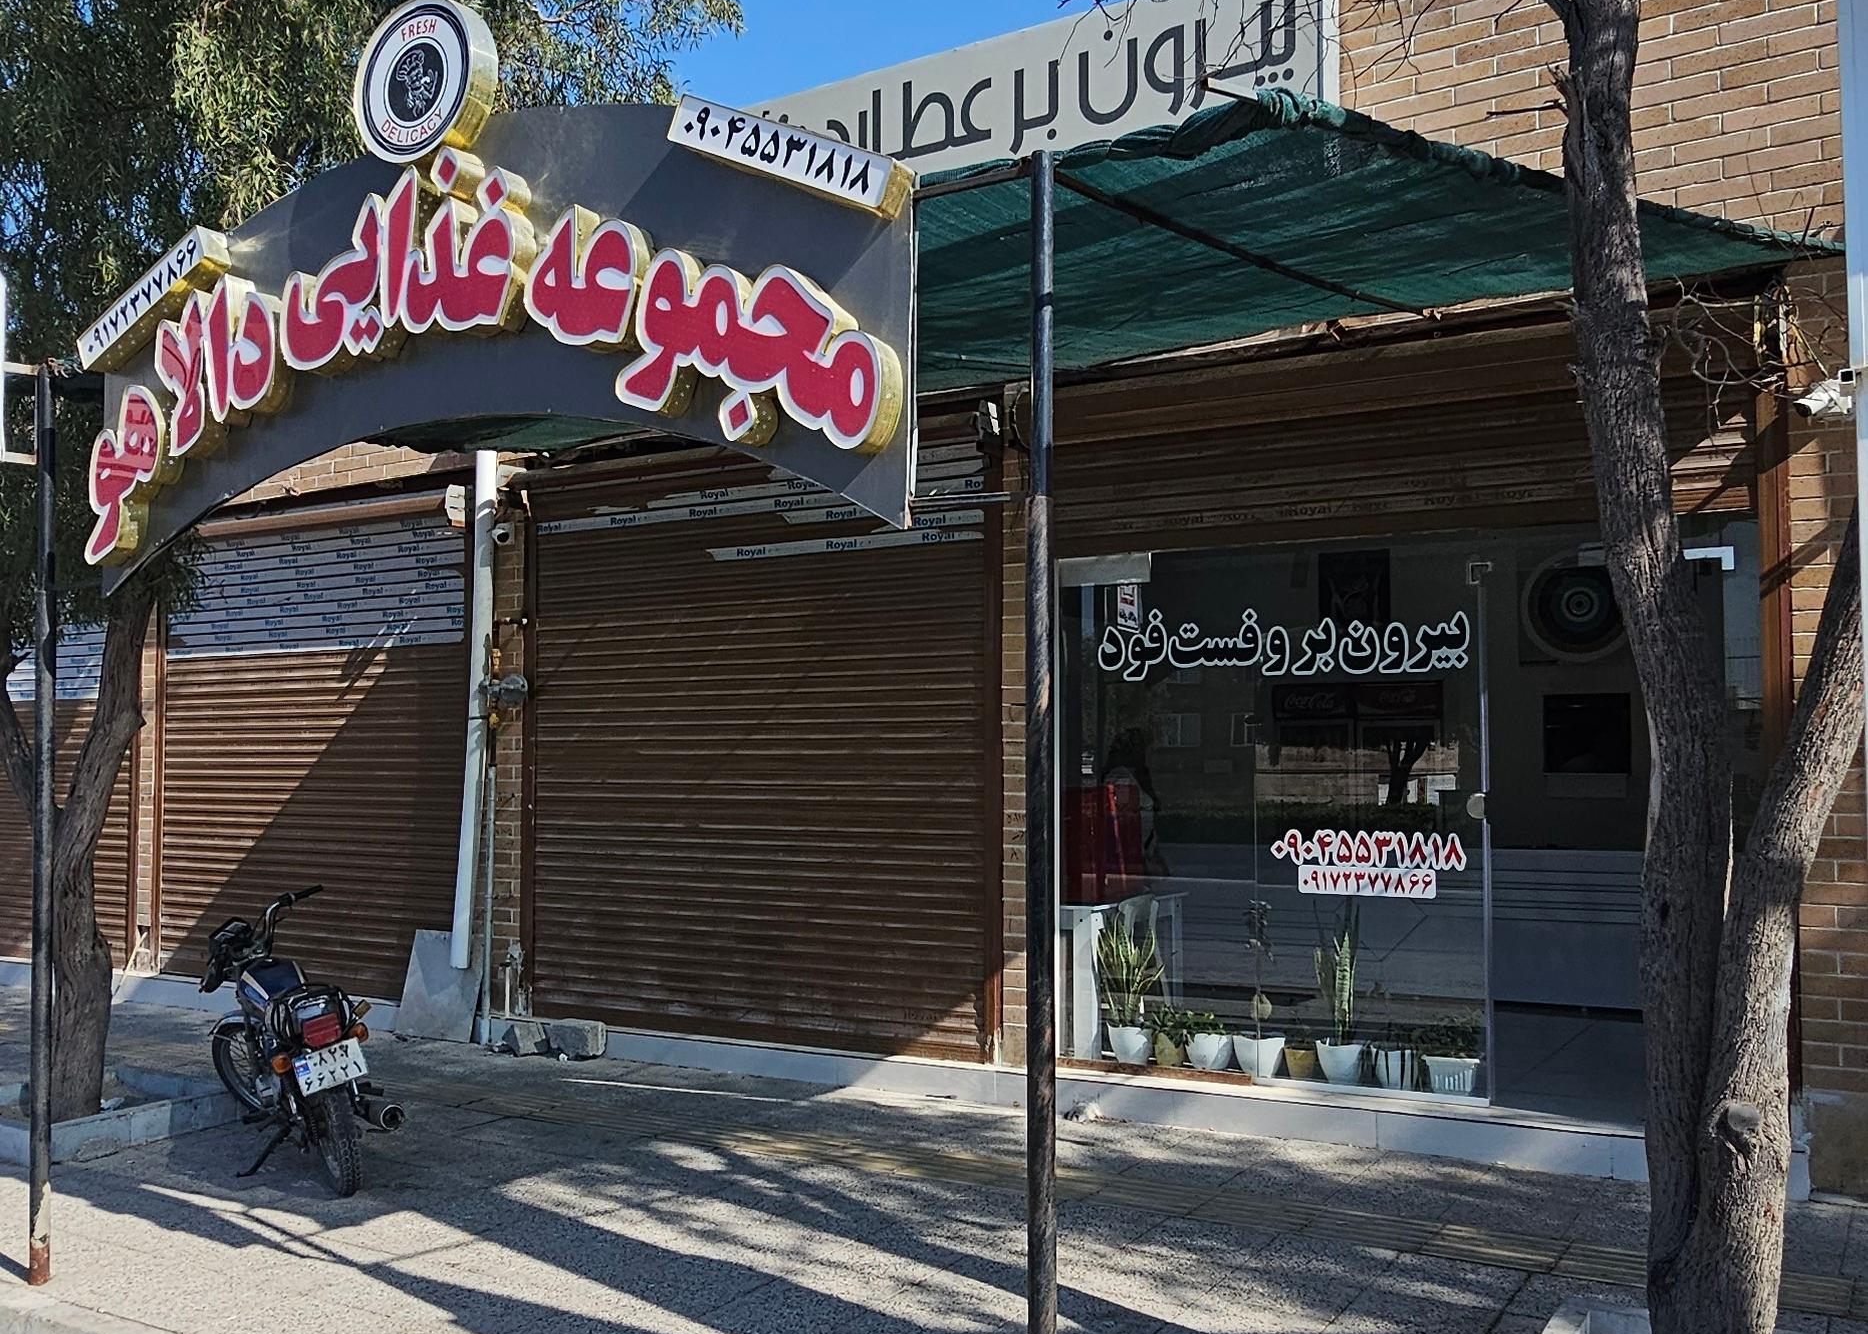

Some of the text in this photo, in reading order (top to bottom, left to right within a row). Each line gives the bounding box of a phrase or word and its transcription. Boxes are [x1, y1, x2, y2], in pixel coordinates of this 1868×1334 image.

[401, 18, 438, 43] FRESH
[1009, 58, 1059, 155] بر
[381, 107, 444, 144] DELICACY
[684, 106, 870, 196] ۰۹۰۴۵۵۳۱۸۱۸
[88, 238, 197, 353] ۰۹۱۷۲۳۷۷۸۶۶
[84, 146, 882, 566] مجموعه غذایی دالاهو
[787, 478, 819, 490] Roya
[610, 515, 637, 529] Royal
[689, 507, 717, 522] Royal
[774, 497, 804, 511] Royal
[825, 508, 857, 520] Royal
[913, 514, 947, 528] Royal
[736, 547, 766, 559] Royal
[825, 539, 857, 553] Royal
[1097, 608, 1470, 682] بیرون بر و فست فود
[1270, 829, 1467, 871] ۰۹۰۴۵۵۳۱۸۱۸
[1302, 869, 1433, 895] ۰۹۱۷۲۳۷۷۸۶۶
